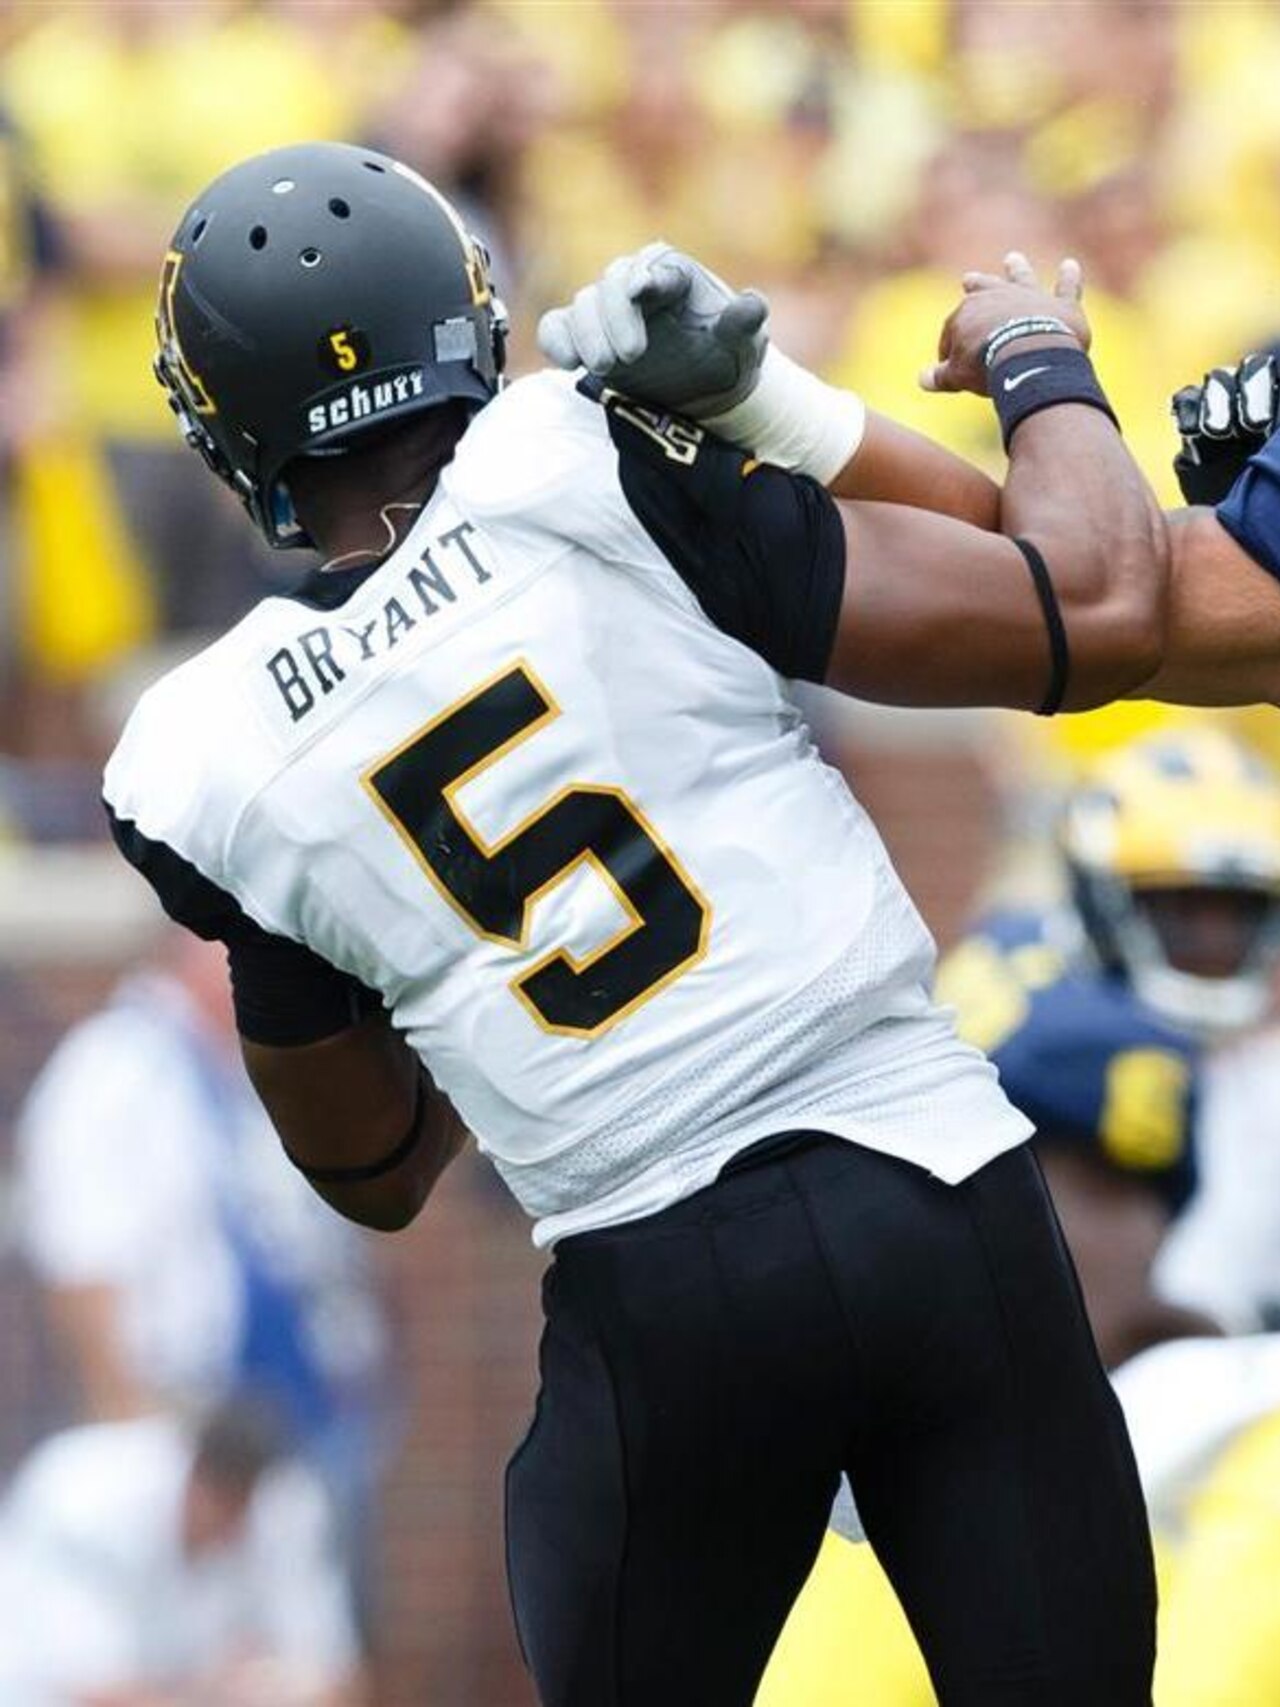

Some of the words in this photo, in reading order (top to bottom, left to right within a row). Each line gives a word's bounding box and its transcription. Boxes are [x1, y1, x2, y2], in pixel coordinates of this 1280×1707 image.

[308, 370, 424, 433] schutt
[329, 331, 358, 370] 5
[266, 520, 493, 723] BRYANT
[359, 656, 714, 1040] 5
